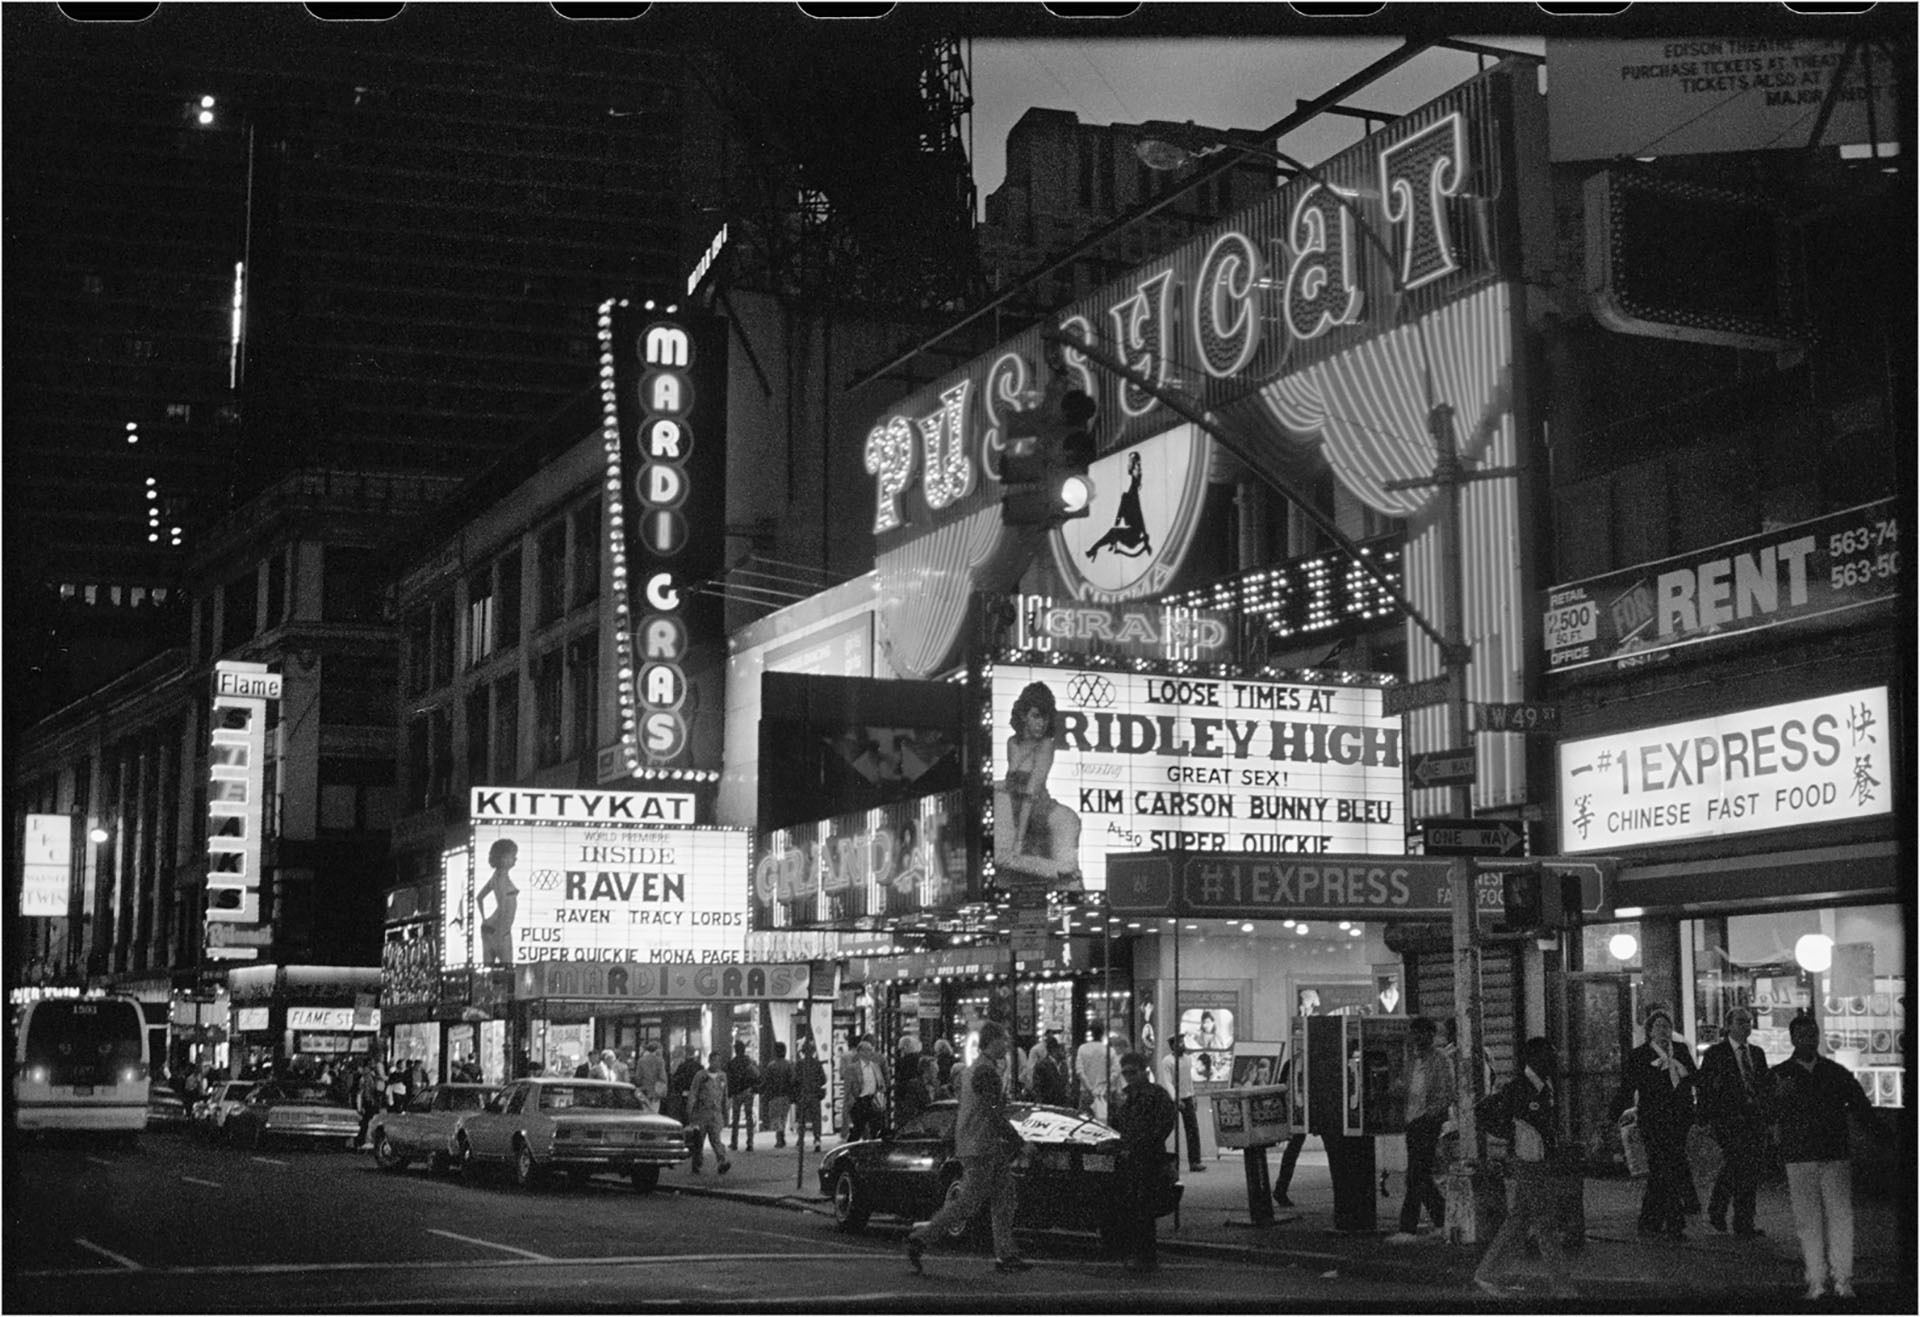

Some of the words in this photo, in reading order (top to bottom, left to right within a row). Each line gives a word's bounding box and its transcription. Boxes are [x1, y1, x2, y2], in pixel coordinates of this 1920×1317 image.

[1664, 43, 1723, 59] EDISON
[1621, 62, 1698, 81] PURCHASE
[1703, 58, 1763, 75] TICKETS
[1680, 75, 1750, 94] TICKETS
[1753, 73, 1796, 89] ALSO
[1801, 70, 1821, 85] AT
[1550, 588, 1588, 607] RETAIL
[1657, 535, 1816, 635] RENT
[1046, 608, 1226, 648] GRAND
[646, 572, 681, 751] GRAS
[1550, 646, 1590, 664] OFFICE
[221, 673, 279, 697] Flame
[1147, 678, 1220, 706] LOOSE
[1233, 684, 1301, 711] TIMES
[1308, 690, 1336, 713] AT
[1511, 707, 1538, 728] 49
[1053, 710, 1258, 759] RIDLEY
[1270, 721, 1401, 768] HIGH
[1639, 712, 1842, 792] EXPRESS
[1846, 701, 1882, 808] 快餐
[1167, 766, 1233, 785] GREAT
[1241, 768, 1289, 786] SEX!
[476, 791, 689, 821] KITTYKAT
[1079, 788, 1123, 814] KIM
[1135, 792, 1235, 818] CARSON
[1249, 796, 1327, 821] BUNNY
[1337, 800, 1393, 823] BLEU
[1606, 802, 1691, 833] CHINESE
[1707, 792, 1760, 822] FAST
[1775, 782, 1837, 812] FOOD
[584, 832, 617, 842] WORLD
[620, 832, 671, 843] PREMIERE
[1106, 821, 1143, 848] ALSO
[1432, 829, 1462, 845] ONE
[1480, 829, 1511, 844] WAY
[581, 846, 676, 865] INSIDE
[756, 829, 894, 904] GRAND
[566, 870, 685, 902] RAVEN
[1253, 866, 1410, 903] EXPRESS
[555, 909, 611, 924] RAVEN
[629, 910, 684, 926] TRACY
[691, 911, 743, 927] LORDS
[520, 928, 562, 943] PLUS
[516, 946, 569, 962] SUPER
[650, 948, 696, 964] MONA
[701, 949, 740, 965] PAGE
[550, 965, 669, 996] MARDI
[693, 966, 792, 998] GRAS
[291, 1012, 331, 1024] FLAME
